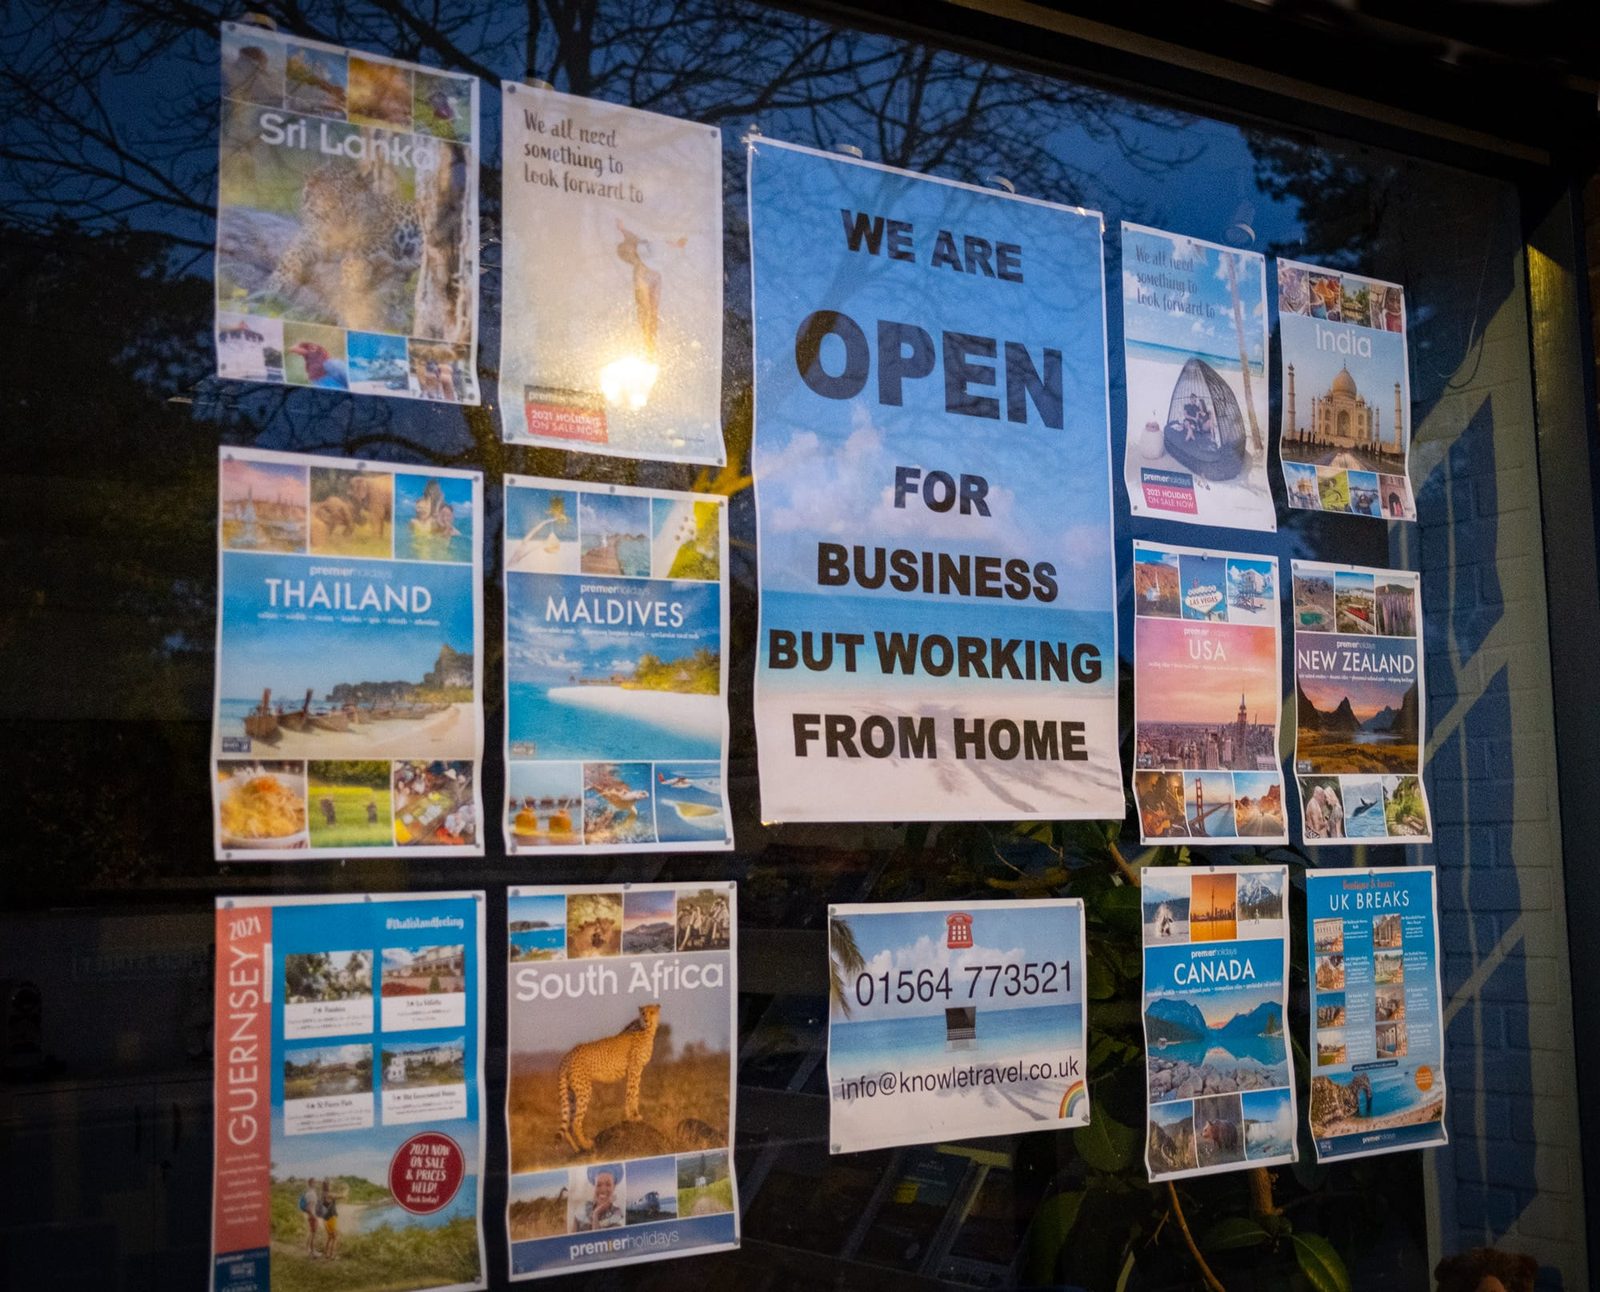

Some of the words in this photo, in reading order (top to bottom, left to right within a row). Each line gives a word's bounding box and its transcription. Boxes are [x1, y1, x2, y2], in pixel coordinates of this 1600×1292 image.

[259, 113, 306, 149] Sri
[320, 123, 439, 171] Lanka
[523, 108, 545, 134] We
[551, 119, 575, 140] all
[579, 129, 617, 148] need
[523, 143, 603, 177] something
[609, 154, 624, 174] to
[523, 162, 559, 188] look
[563, 171, 625, 201] forward
[630, 181, 645, 203] to
[840, 208, 916, 263] WE
[930, 229, 1023, 284] ARE
[1135, 244, 1151, 264] We
[1152, 250, 1169, 267] all
[1170, 257, 1194, 273] need
[1136, 272, 1185, 297] something
[1188, 279, 1199, 294] to
[1137, 287, 1160, 308] look
[1163, 294, 1204, 316] forward
[1205, 302, 1216, 319] to
[1315, 323, 1372, 359] India
[795, 308, 1064, 430] OPEN
[893, 465, 992, 518] FOR
[1146, 488, 1161, 497] 2021
[1162, 490, 1194, 501] HOLIDAYS
[1149, 496, 1160, 504] ON
[1161, 497, 1175, 507] SALE
[1176, 500, 1195, 510] NOW
[818, 542, 1059, 603] BUSINESS
[264, 578, 432, 614] THAILAND
[545, 595, 684, 629] MALDIVES
[768, 628, 865, 673] BUT
[873, 630, 1103, 684] WORKING
[1189, 639, 1227, 661] USA
[1298, 650, 1338, 671] NEW
[1342, 652, 1415, 674] ZEALAND
[792, 713, 938, 760] FROM
[953, 717, 1089, 761] HOME
[1329, 893, 1350, 911] UK
[1356, 889, 1410, 910] BREAKS
[229, 916, 261, 940] 2021
[515, 964, 618, 1002] South
[627, 959, 724, 999] Africa
[856, 966, 954, 1007] 01564
[964, 960, 1072, 999] 773521
[1173, 958, 1256, 986] CANADA
[228, 944, 259, 1146] GUERNSEY
[840, 1055, 1081, 1101] info@knowletravel.co.uk
[410, 1143, 430, 1156] 2021
[432, 1143, 449, 1156] NOW
[410, 1156, 422, 1168] ON
[425, 1157, 446, 1169] SALE
[405, 1169, 414, 1180] &
[416, 1169, 447, 1181] PRICES
[411, 1181, 438, 1193] HELD!
[570, 1229, 681, 1260] premierholidays
